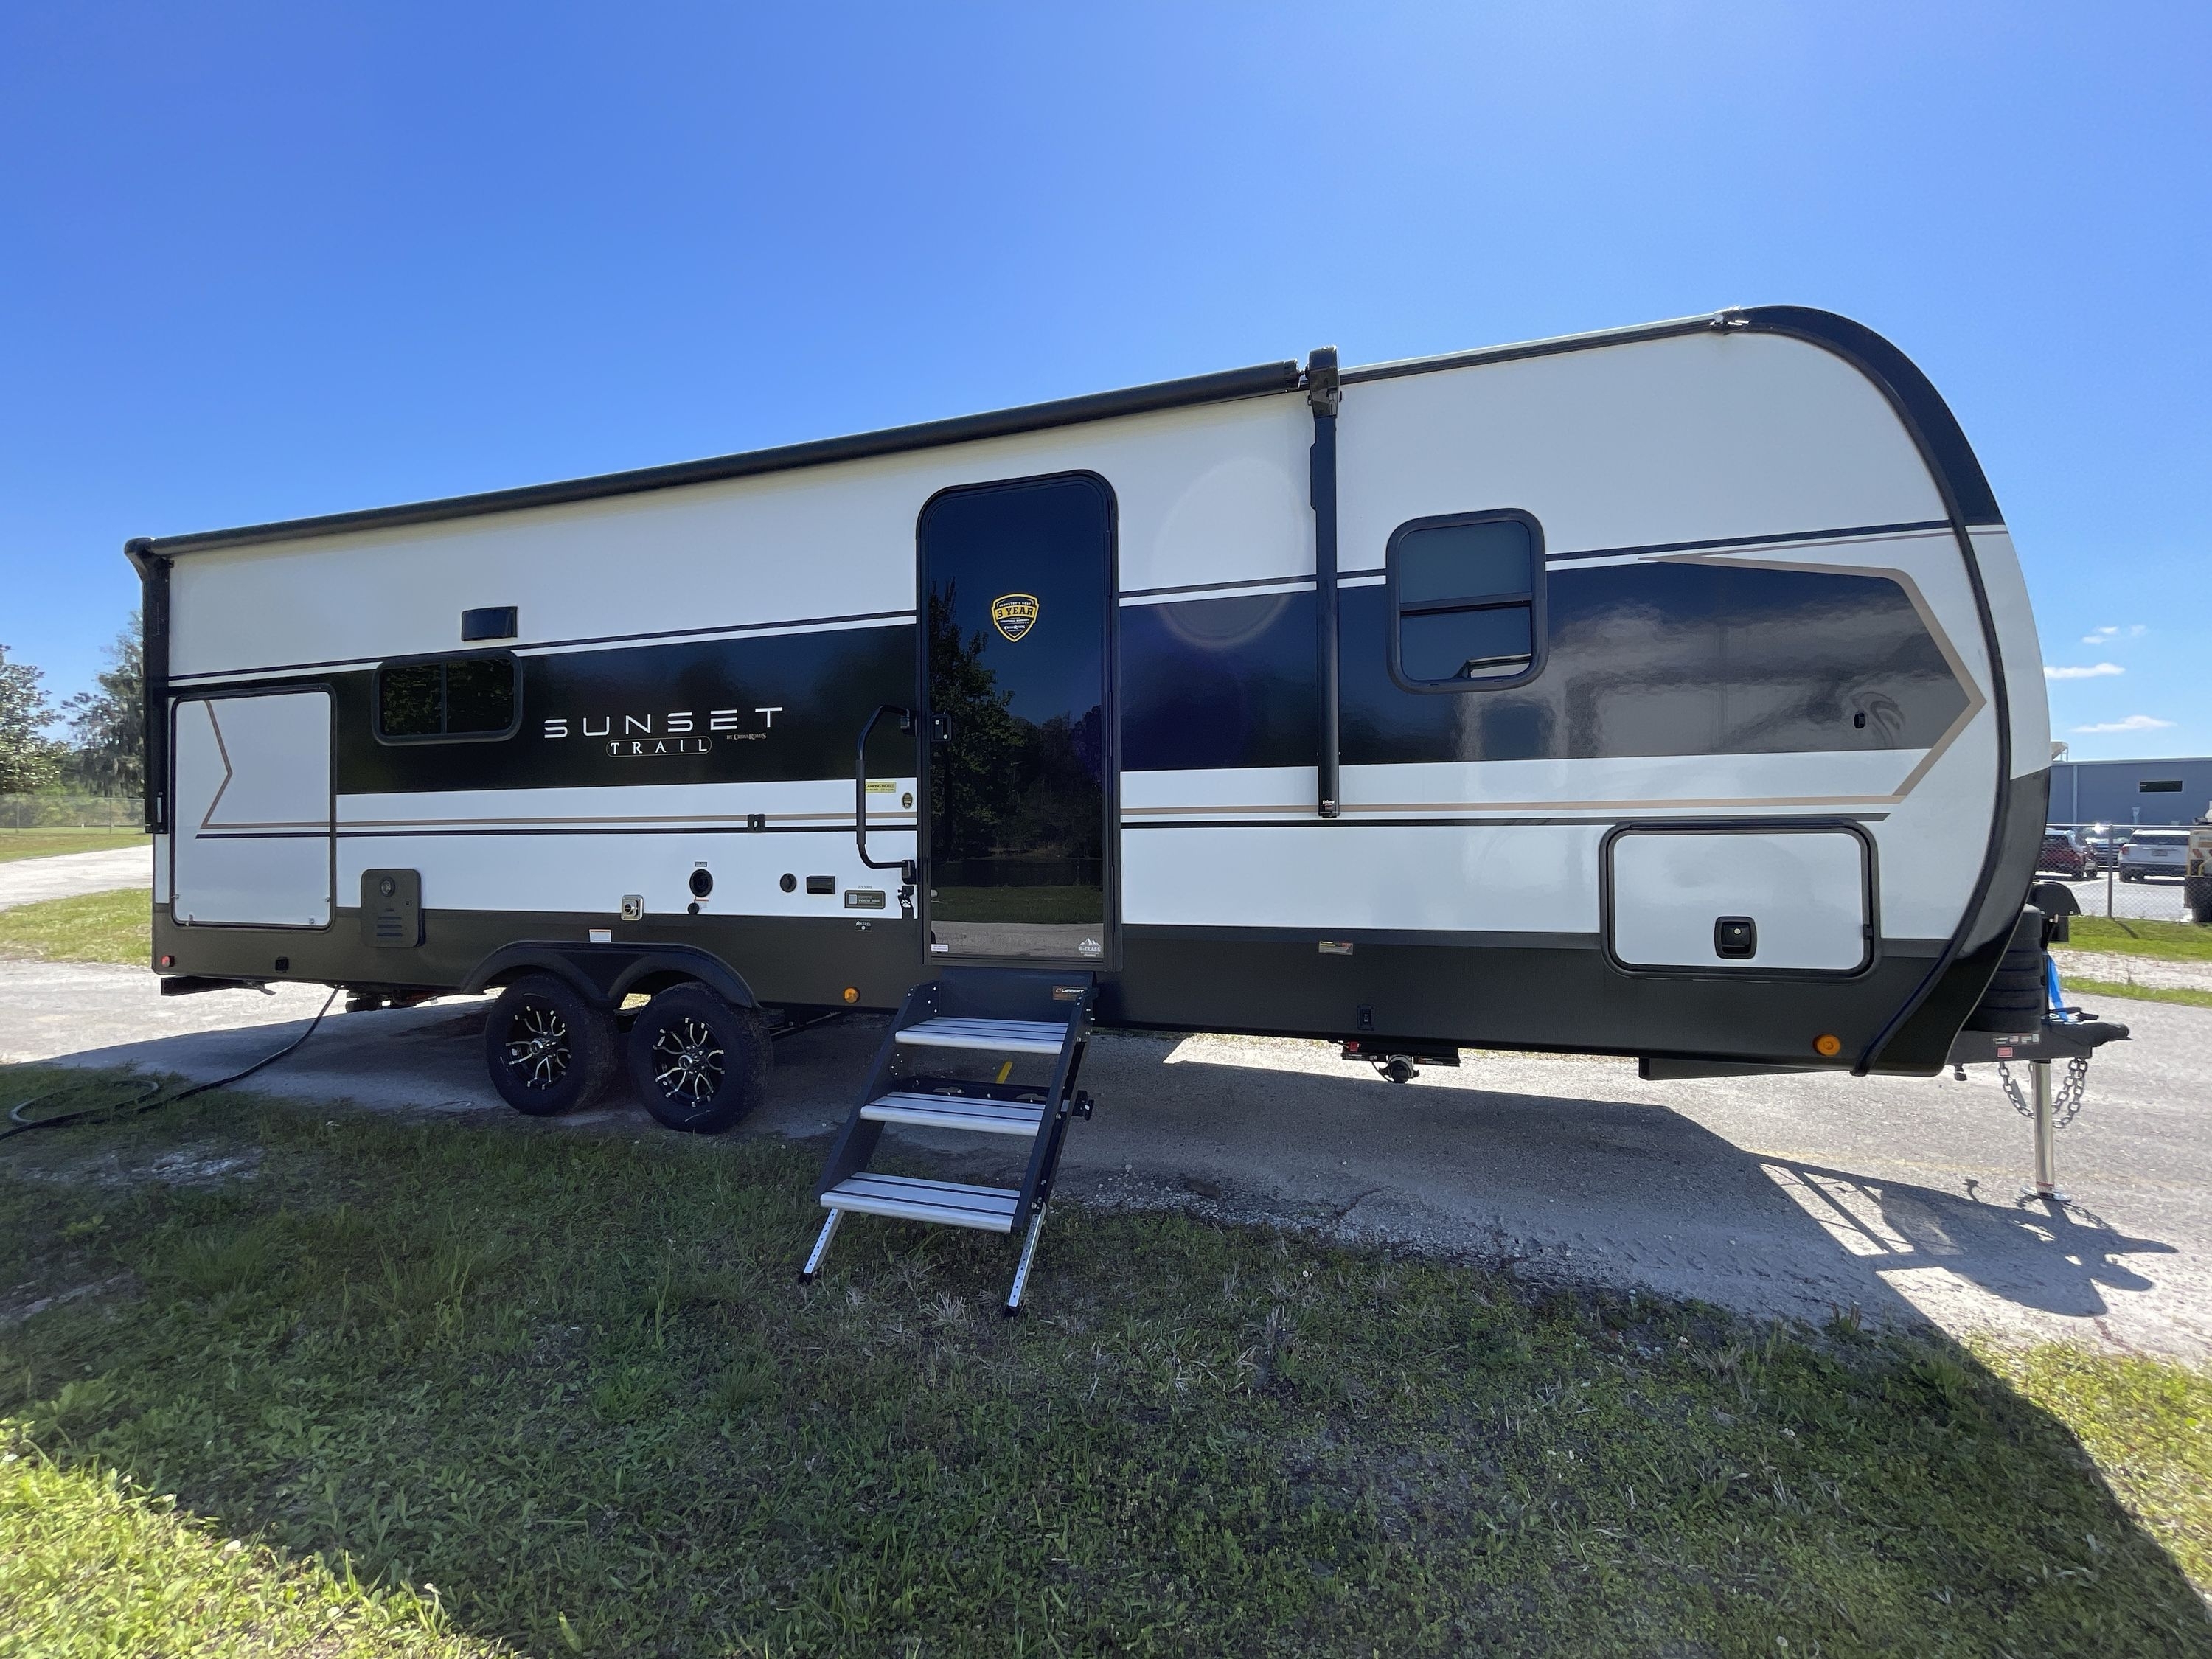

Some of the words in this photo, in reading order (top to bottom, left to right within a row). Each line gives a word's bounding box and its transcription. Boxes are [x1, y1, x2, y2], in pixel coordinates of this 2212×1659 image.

[997, 609, 1004, 618] 3
[1006, 607, 1033, 616] YEAR
[543, 706, 783, 739] SUNSET
[610, 739, 708, 755] TRAIL
